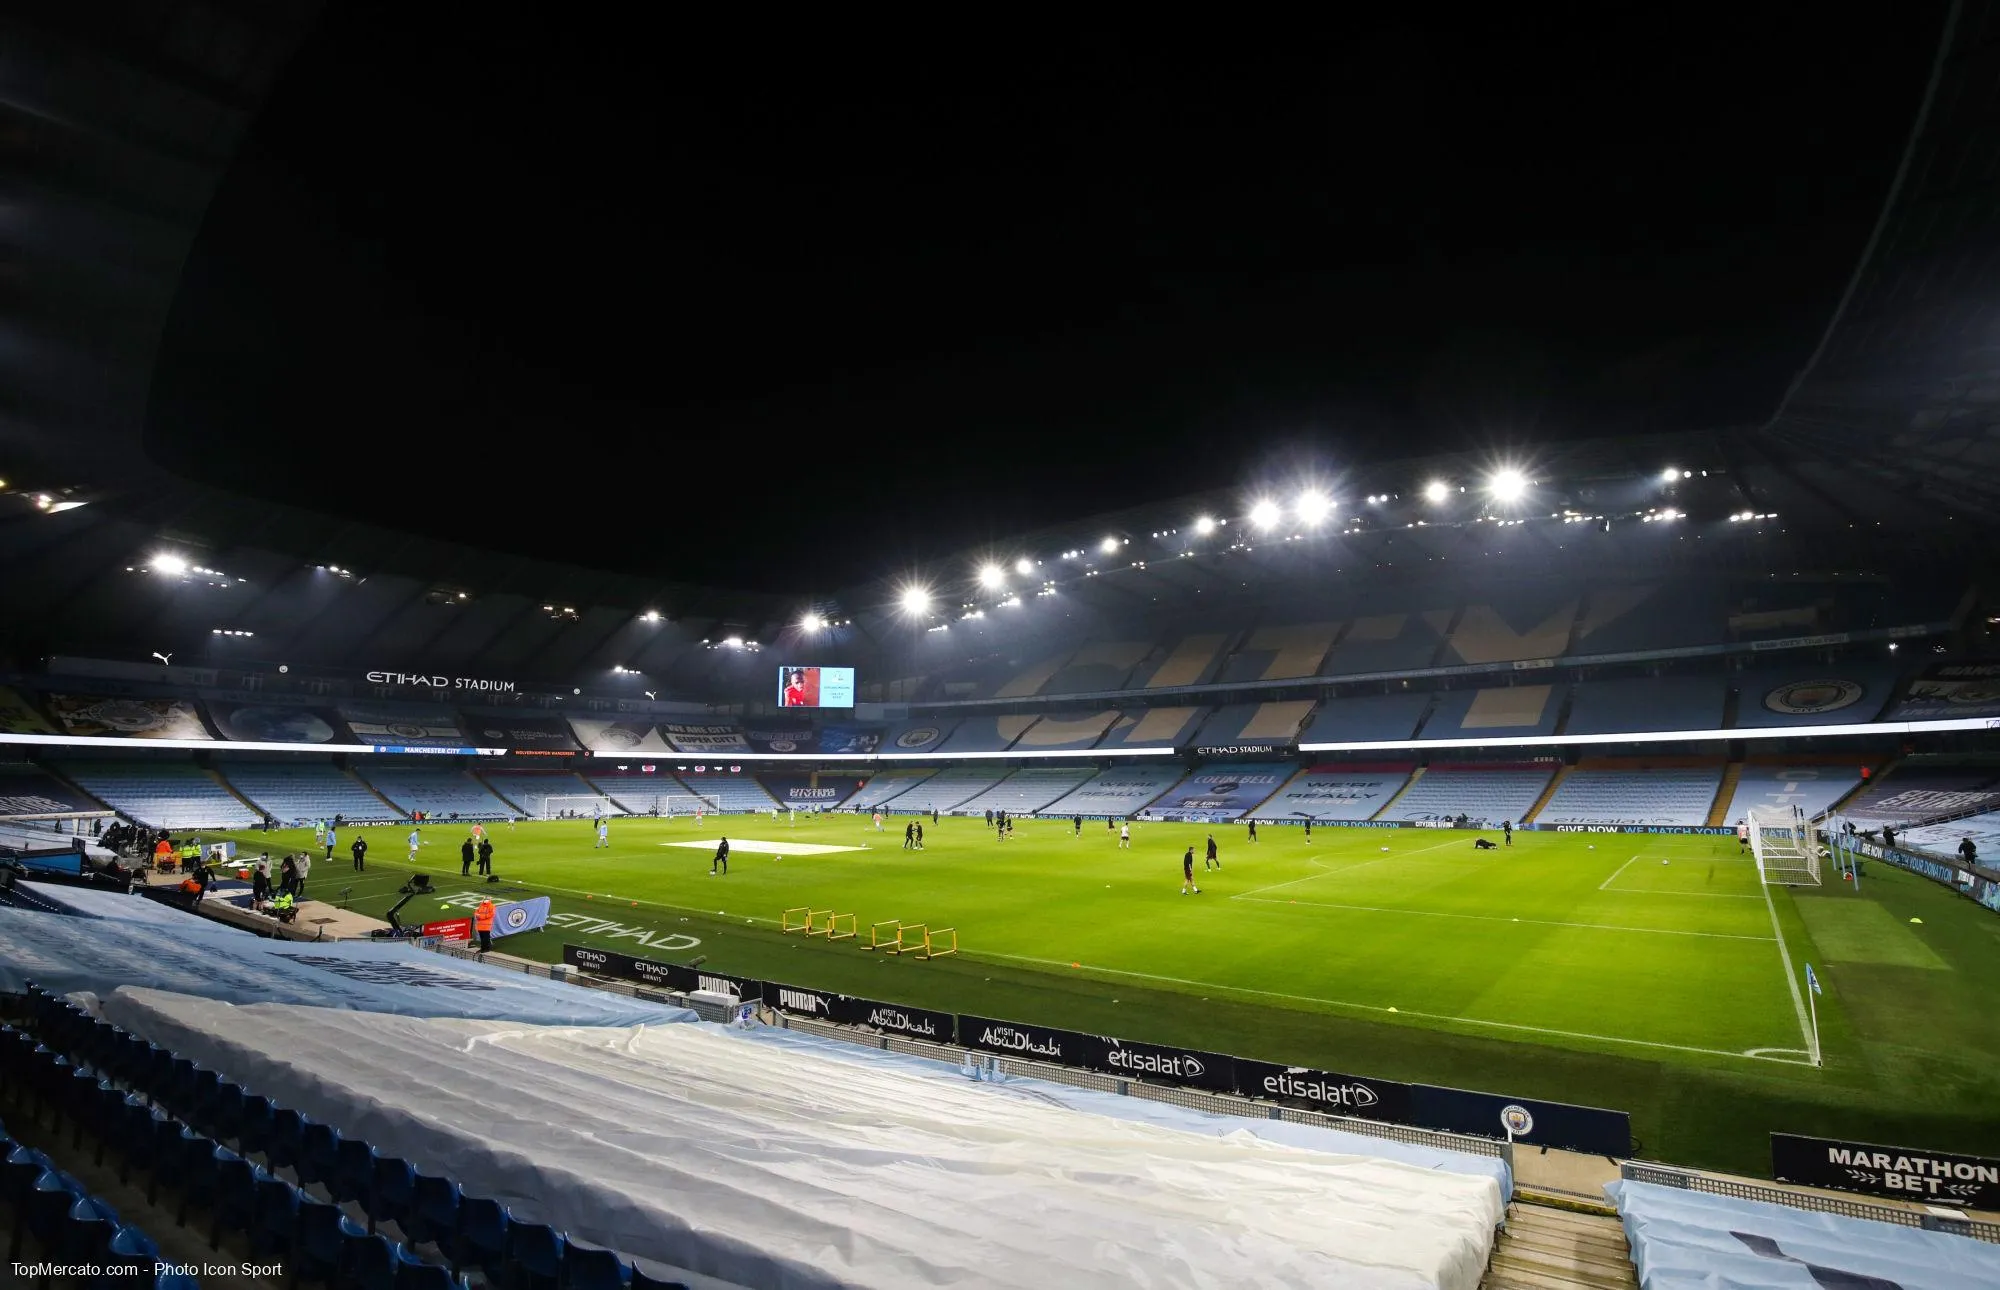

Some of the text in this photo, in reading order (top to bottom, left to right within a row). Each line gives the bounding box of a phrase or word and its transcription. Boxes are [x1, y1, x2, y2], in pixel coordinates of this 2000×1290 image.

[366, 671, 515, 692] ETIHAD STADIUM
[1194, 775, 1276, 784] COLIN BELL
[1871, 845, 1884, 859] NOW
[1923, 860, 1953, 883] DONATION
[546, 912, 701, 950] ETIHAD
[576, 950, 607, 964] ETIHAD
[635, 961, 669, 977] ETIHAD
[698, 975, 730, 995] PUMA
[779, 988, 817, 1013] PUMA
[881, 1008, 896, 1018] VISIT
[997, 1026, 1015, 1037] VISIT
[1108, 1049, 1182, 1076] etisalat
[1263, 1074, 1353, 1106] etisalat
[1828, 1147, 1999, 1184] MARATHON
[1885, 1172, 1943, 1194] BET
